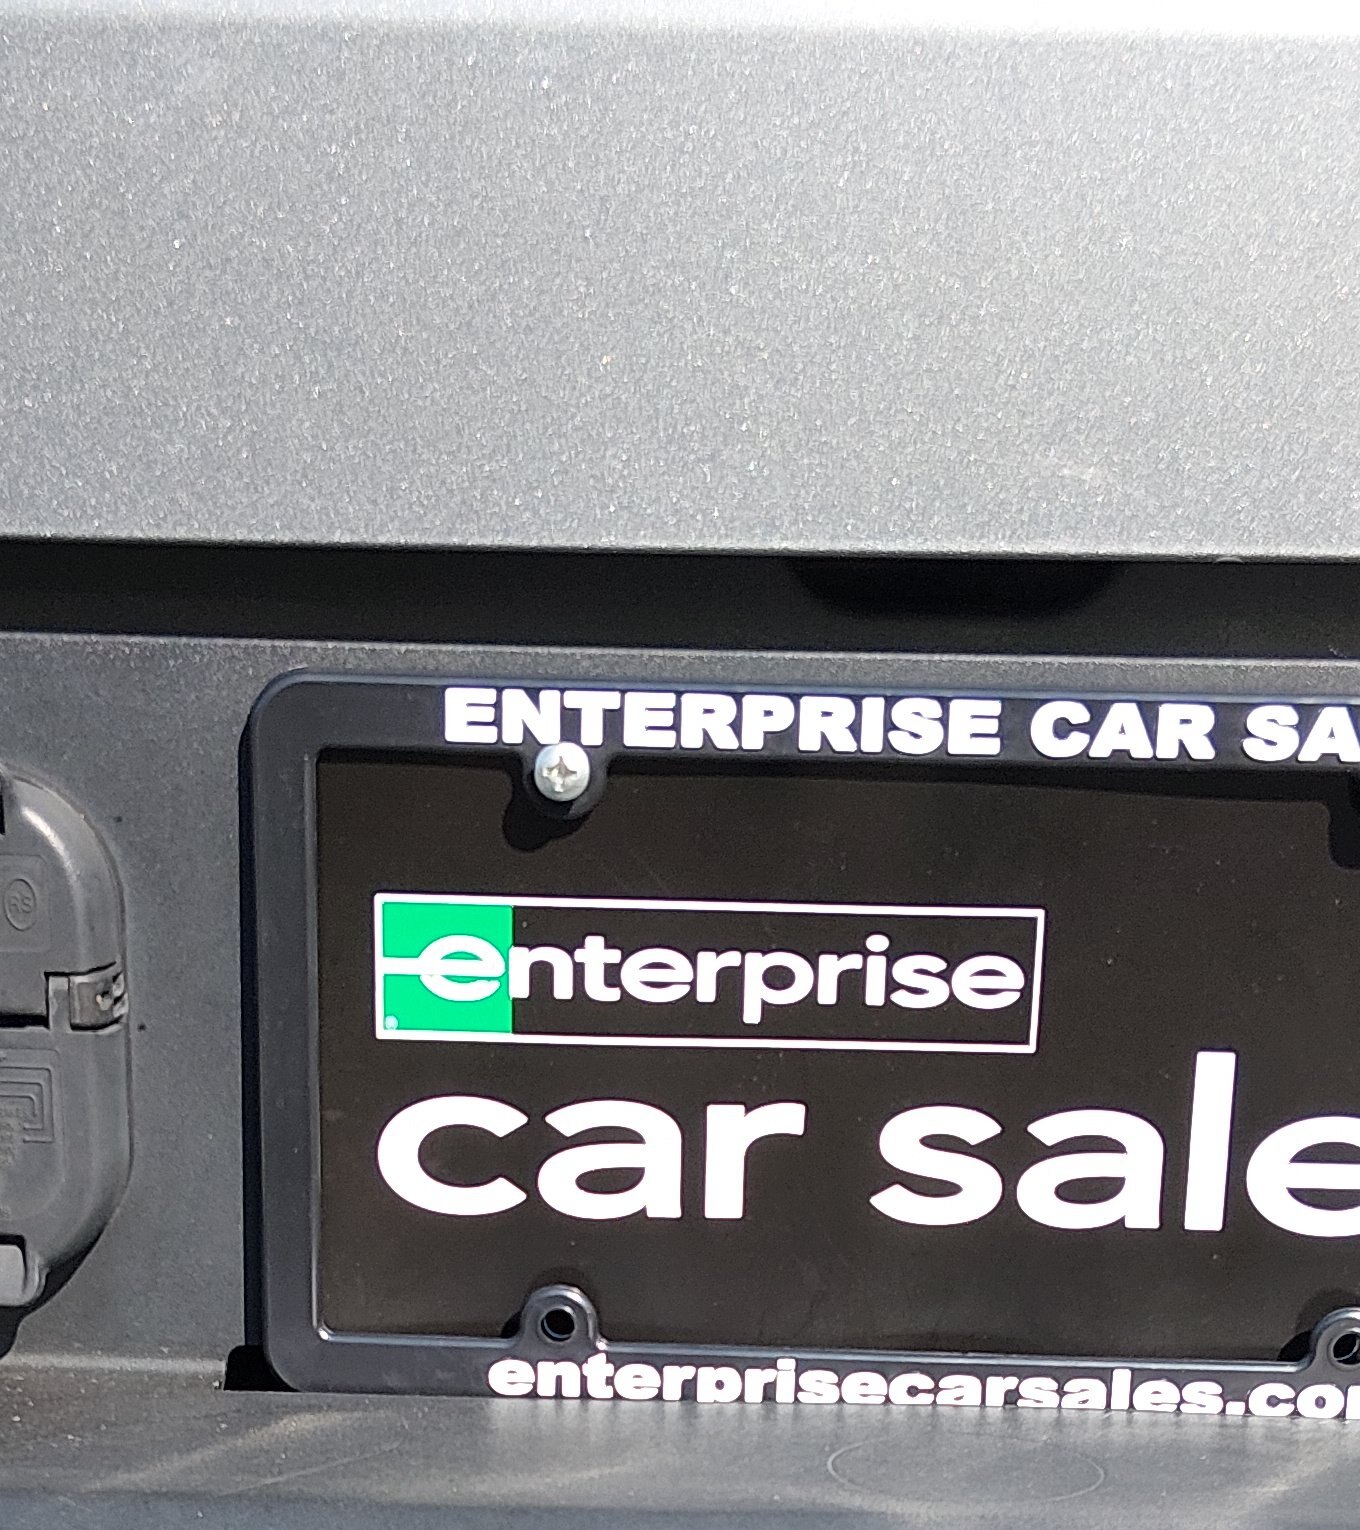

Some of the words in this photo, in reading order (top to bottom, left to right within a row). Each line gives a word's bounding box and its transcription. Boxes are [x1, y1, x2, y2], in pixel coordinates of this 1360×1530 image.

[443, 687, 1003, 756] ENTERPRISE
[1029, 701, 1217, 760] CAR
[418, 934, 1026, 1025] enterprise
[377, 1096, 806, 1219] car
